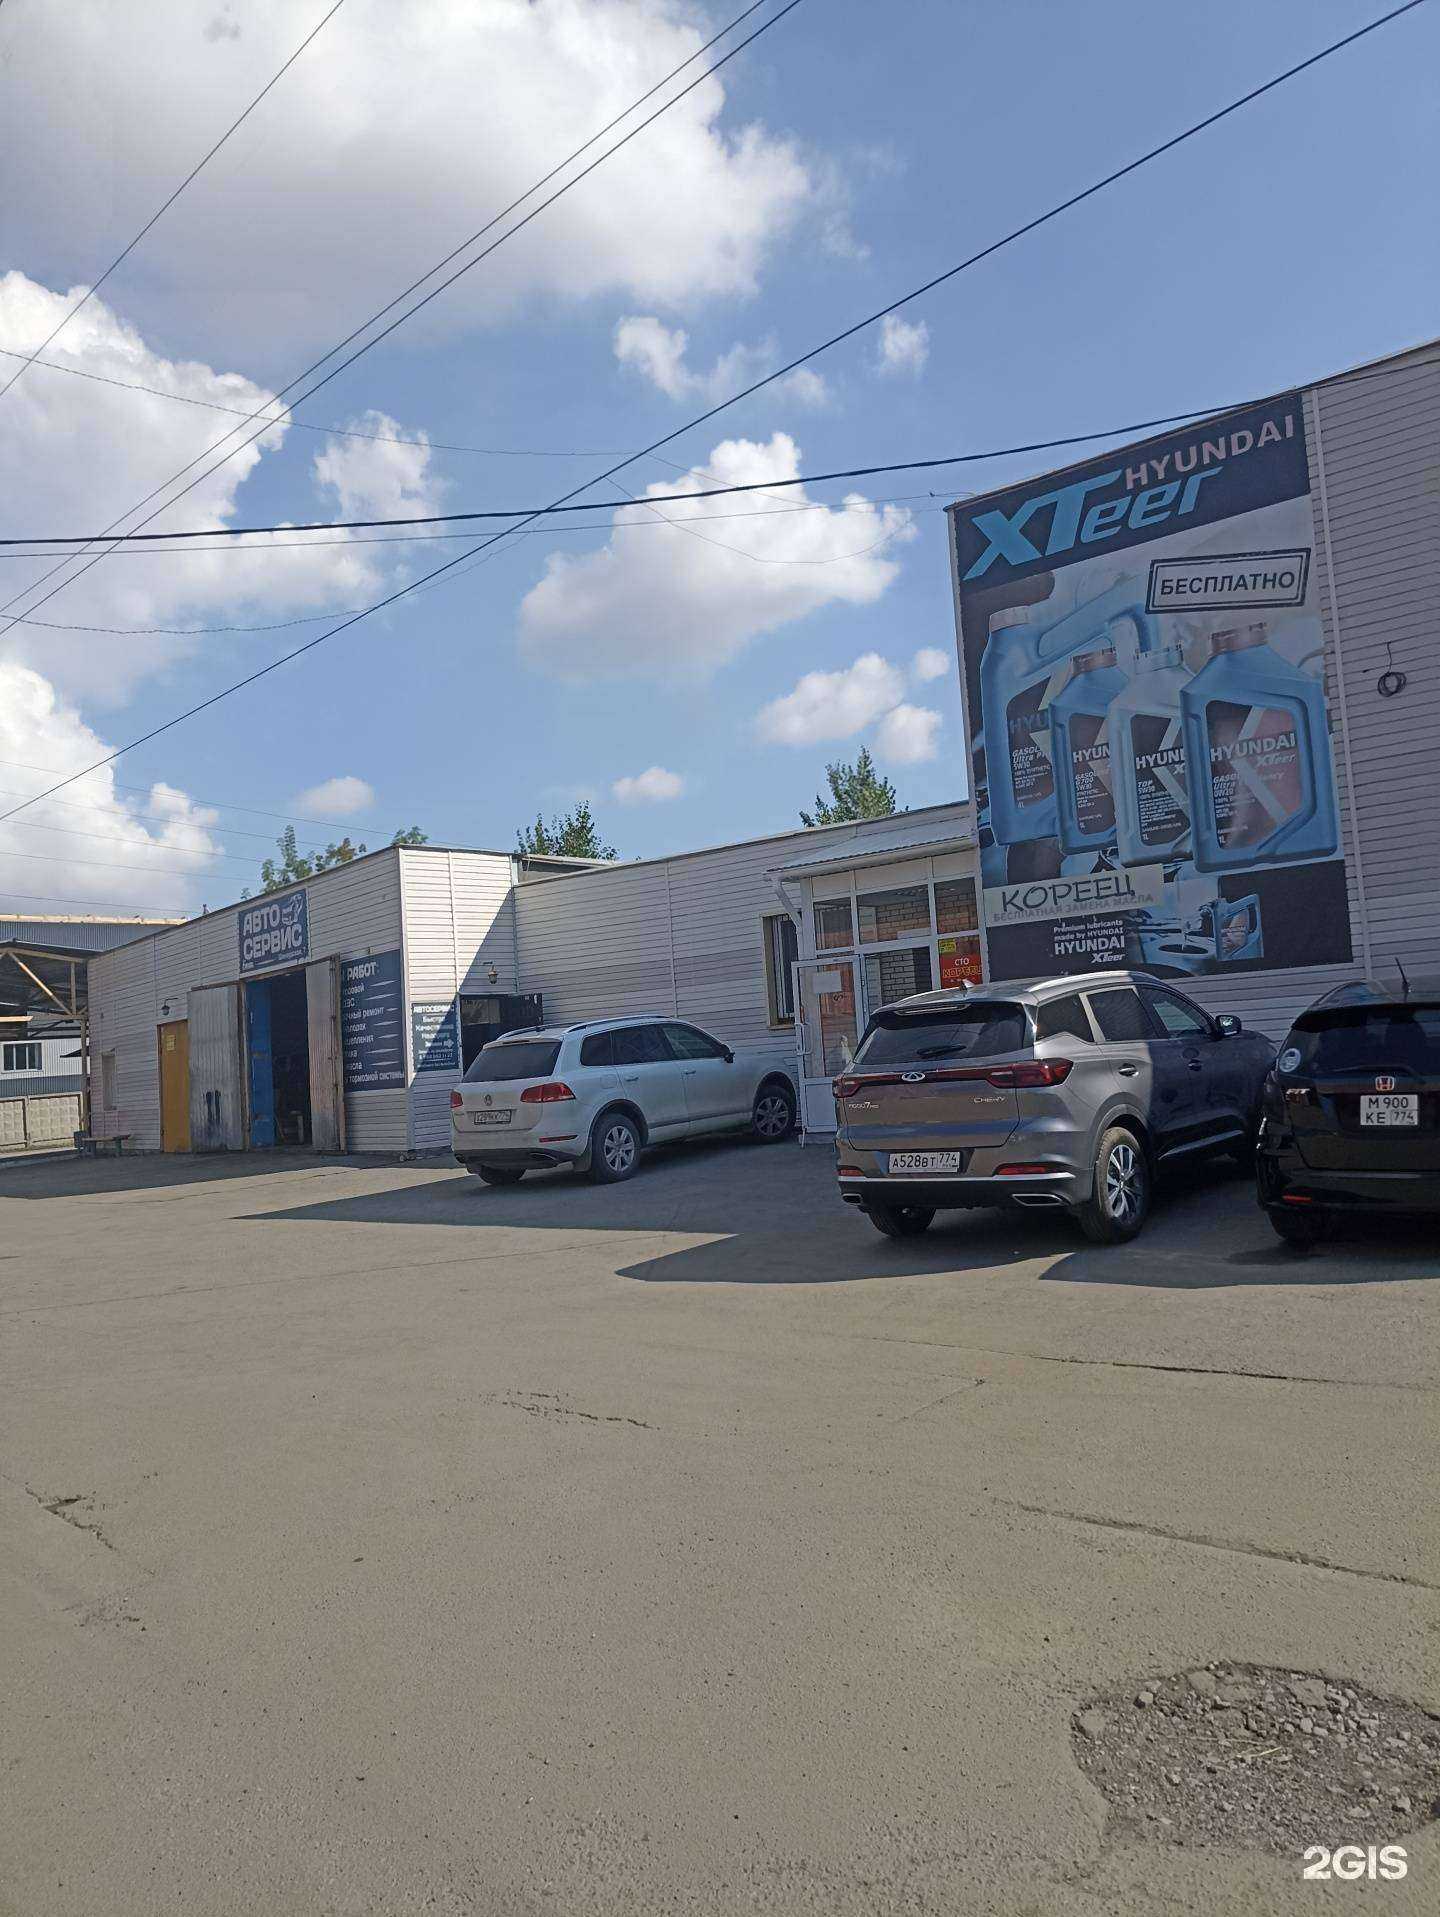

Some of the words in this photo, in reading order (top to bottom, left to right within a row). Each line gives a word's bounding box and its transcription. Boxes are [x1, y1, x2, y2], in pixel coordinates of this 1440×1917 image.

[1125, 414, 1294, 490] HYUNDAI
[962, 466, 1224, 581] XTeer
[1159, 570, 1296, 596] БЕСПЛАТНО
[1210, 733, 1296, 762] HYUNDAI
[1001, 875, 1136, 912] КОРЕЕЦ
[993, 906, 1062, 922] БЕСПЛАТНАЯ
[1066, 902, 1110, 913] ЗАМЕНА
[1112, 895, 1154, 906] МАСЛА
[243, 904, 280, 936] АВТО
[1053, 923, 1085, 933] Premium
[1087, 919, 1124, 929] lubricants
[243, 923, 303, 961] СЕРВИС
[1054, 933, 1075, 942] made
[1075, 932, 1086, 940] by
[1087, 927, 1124, 939] HYUNDAI
[1054, 935, 1125, 955] HYUNDAI
[955, 957, 970, 966] СТО
[1091, 952, 1126, 964] XTeer
[363, 1007, 385, 1018] ремонт
[1384, 1097, 1409, 1109] 900
[1366, 1112, 1386, 1124] КЕ
[1394, 1112, 1414, 1121] 774
[939, 1153, 957, 1164] 774
